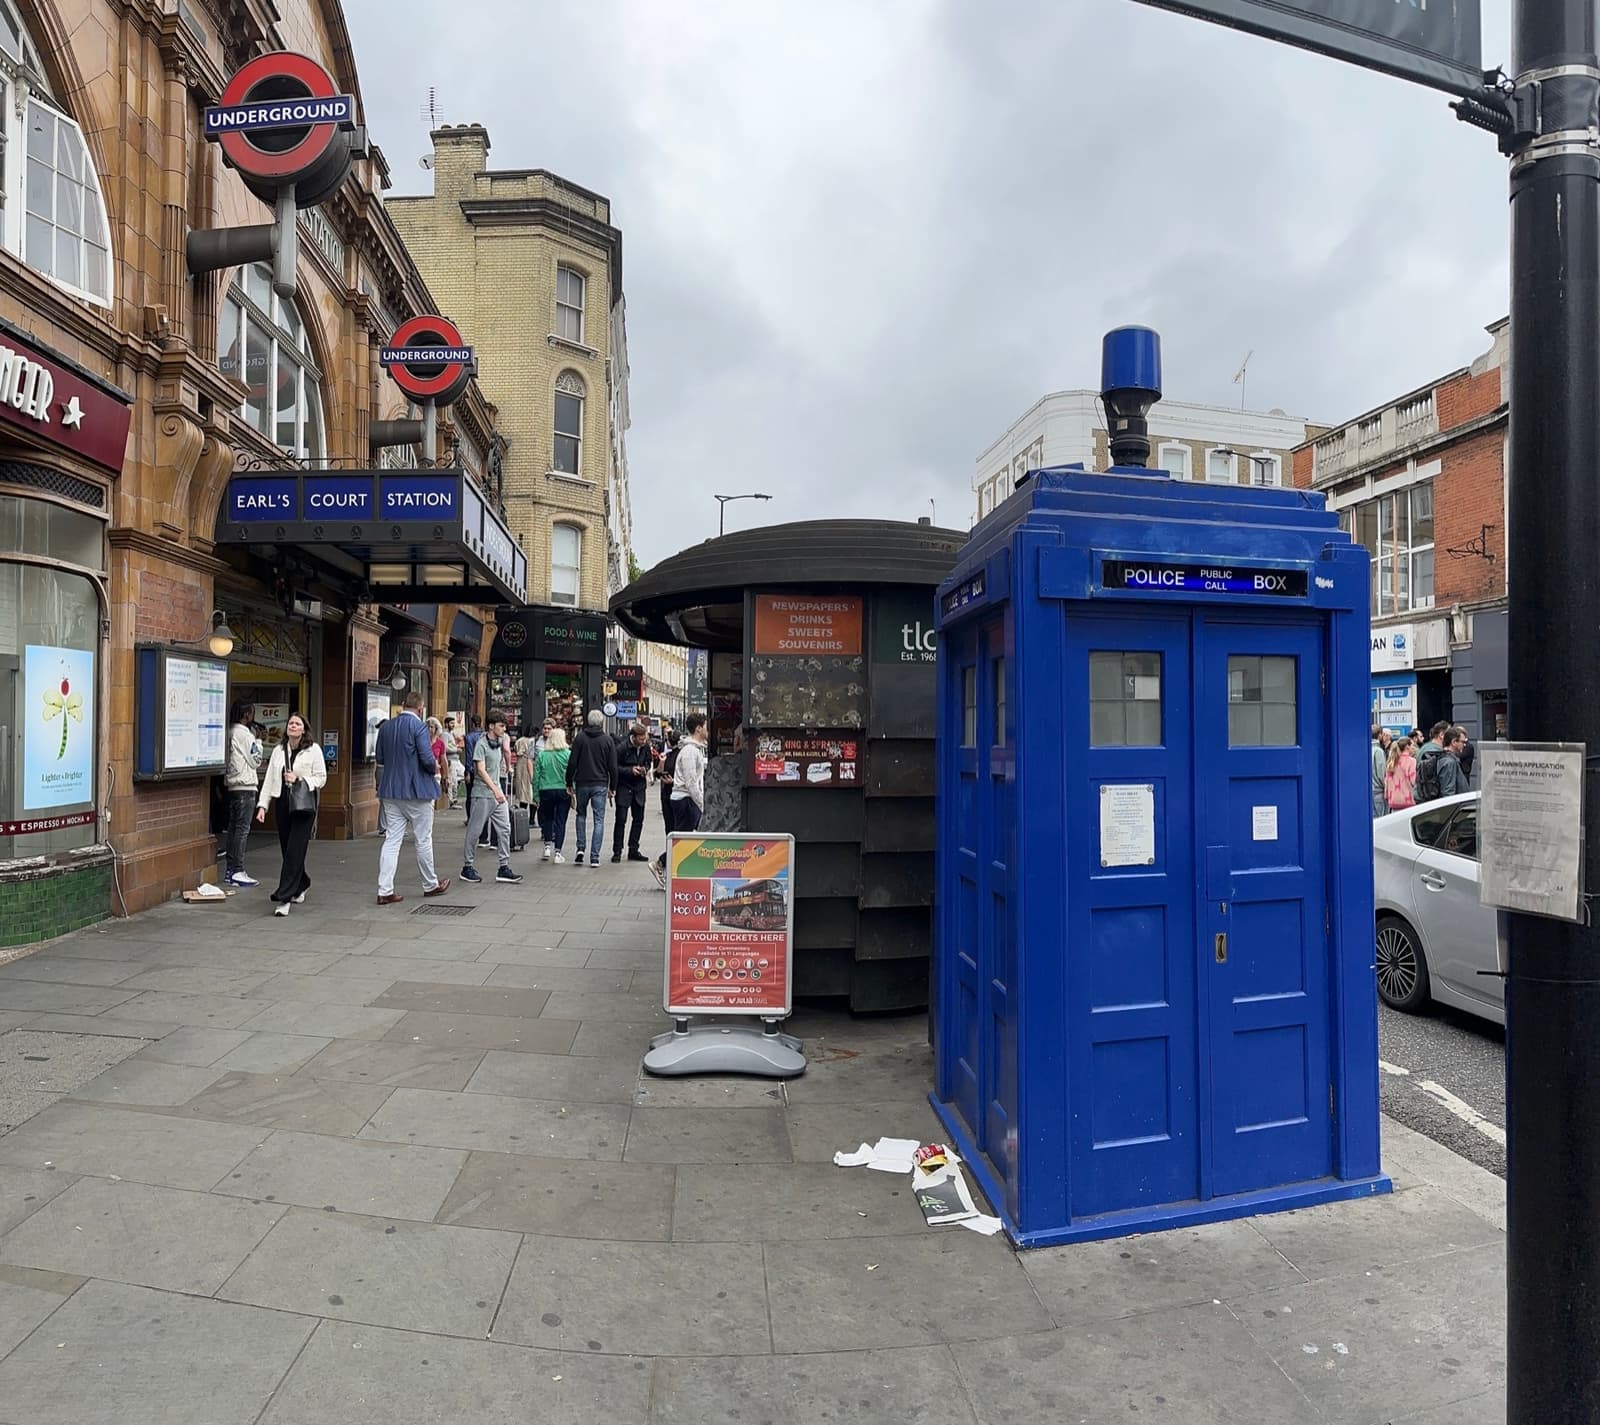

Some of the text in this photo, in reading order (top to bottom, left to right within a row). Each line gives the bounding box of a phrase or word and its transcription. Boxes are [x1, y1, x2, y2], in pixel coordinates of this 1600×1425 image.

[209, 102, 346, 126] UNDERGROUND
[383, 350, 470, 360] UNDERGROUND
[237, 492, 452, 508] EARL'S COURT STATION
[1124, 568, 1287, 590] POLICE BOX
[1200, 569, 1232, 579] PUBLIC
[1204, 581, 1228, 590] CALL
[771, 601, 849, 612] NEWSPAPERS
[790, 615, 833, 625] DRINKS
[544, 626, 598, 641] FOOD & WINE
[787, 628, 833, 638] SWEETS
[778, 640, 844, 650] SOUVENIRS
[900, 651, 916, 661] Est.
[616, 668, 636, 677] ATM
[1389, 700, 1404, 708] ATM
[262, 708, 280, 717] GFC
[1494, 760, 1566, 770] PLANNING APPLICATION
[41, 772, 61, 783] Lighter
[65, 770, 83, 781] Brighter
[21, 815, 85, 831] ESPRESSO MOCHA
[674, 891, 706, 902] Hop On
[673, 905, 706, 915] Hop Off
[673, 932, 785, 942] BUY YOUR TICKETS HERE
